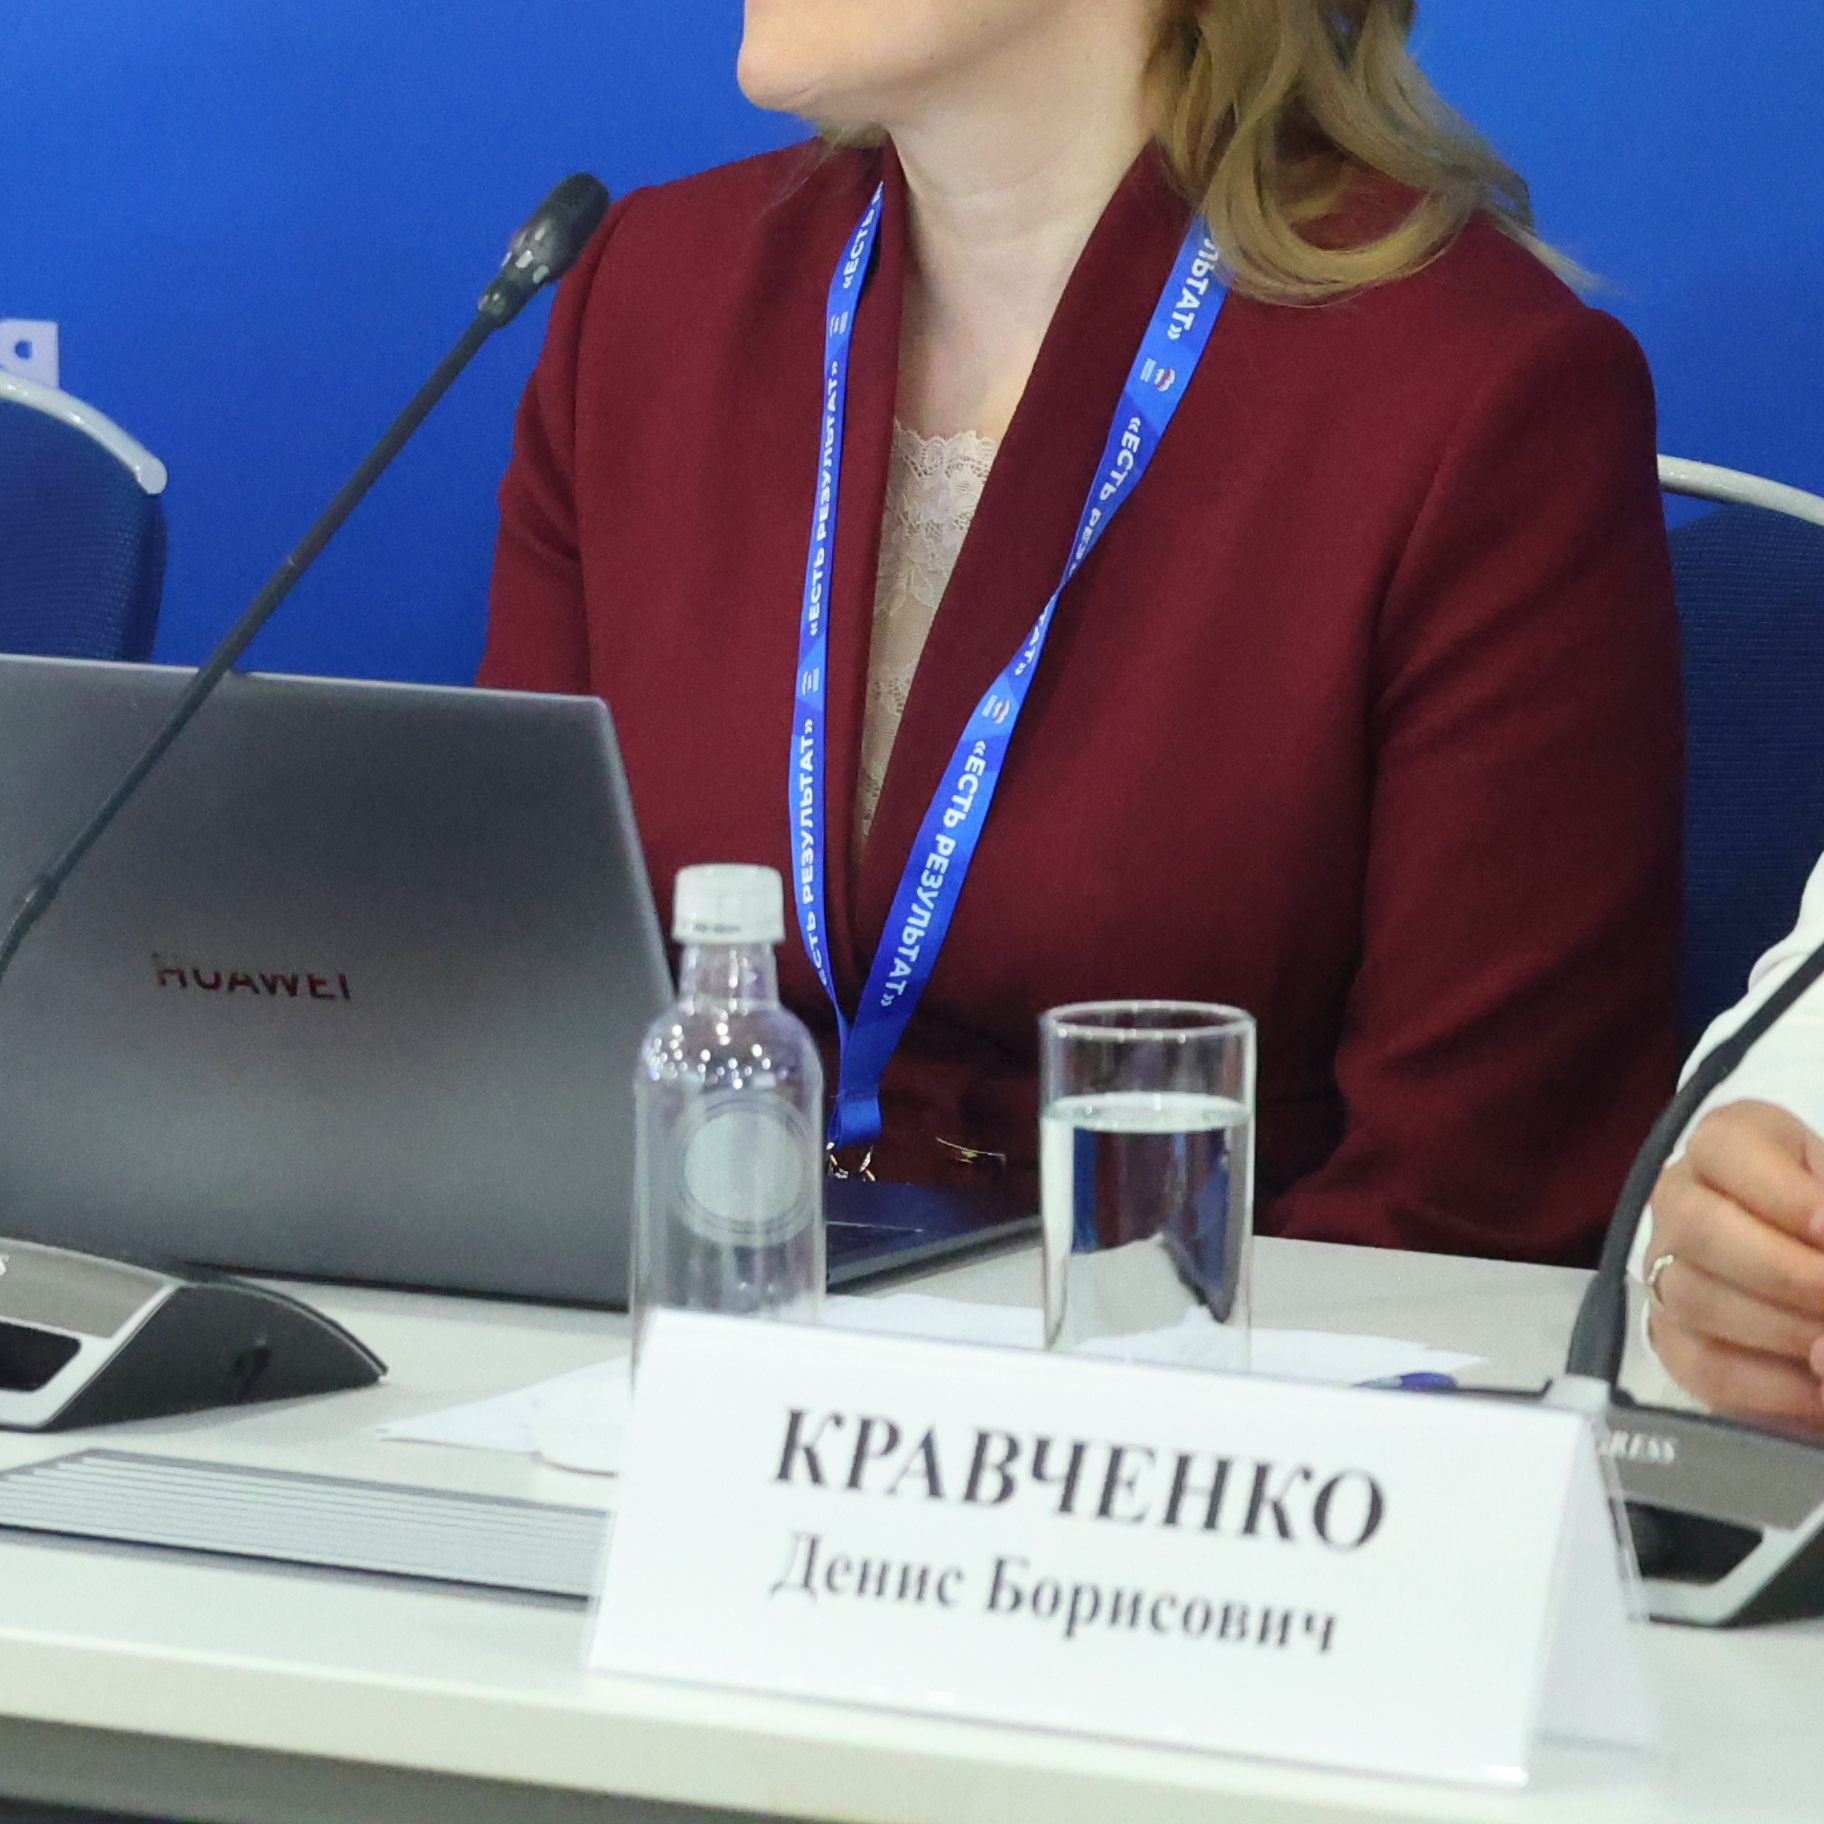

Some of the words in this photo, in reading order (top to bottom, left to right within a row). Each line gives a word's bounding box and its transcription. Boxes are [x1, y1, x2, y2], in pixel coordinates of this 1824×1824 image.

[880, 833, 956, 1008] РЕЗУЛЬТАТ»
[773, 1407, 1387, 1553] КРАВЧЕНКО
[769, 1529, 966, 1609] Денис
[982, 1553, 1340, 1656] Борисович
